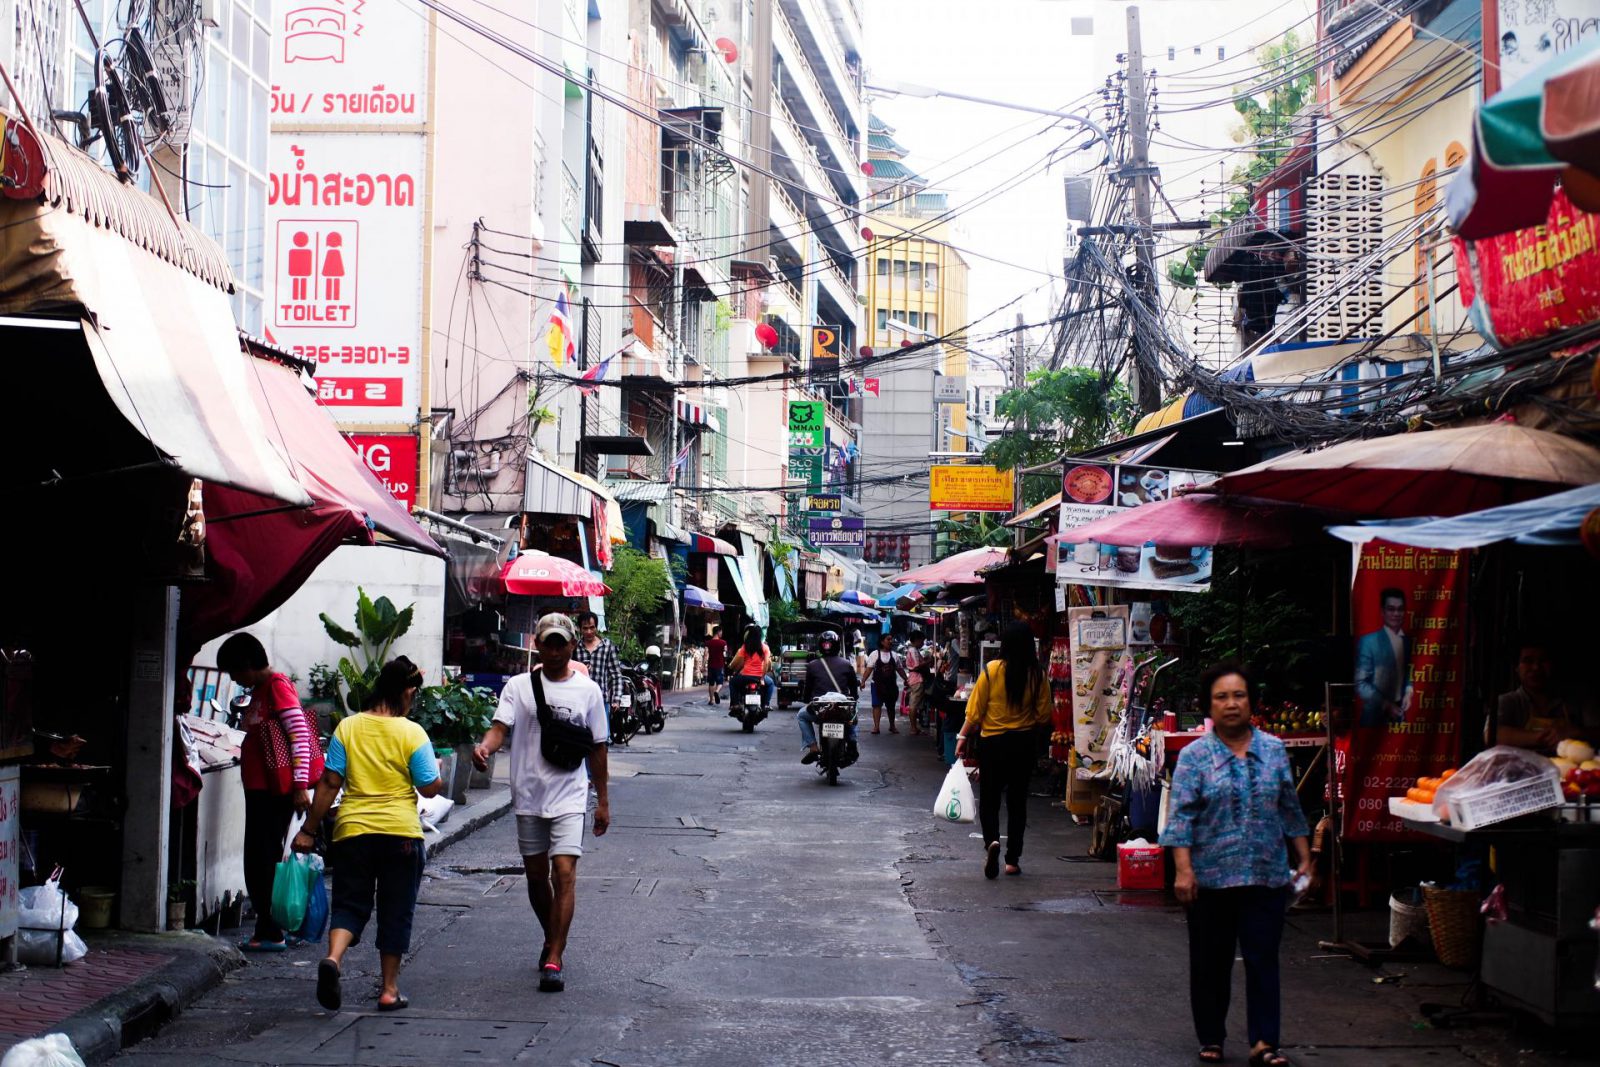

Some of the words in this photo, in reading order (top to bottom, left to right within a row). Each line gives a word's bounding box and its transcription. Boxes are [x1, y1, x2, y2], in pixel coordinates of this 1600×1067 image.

[323, 84, 415, 113] รายเดือน
[280, 305, 351, 321] TOILET
[318, 379, 354, 400] ชั้น
[365, 383, 387, 399] 2
[865, 381, 878, 389] KFC
[1065, 514, 1079, 522] Try
[518, 569, 550, 577] LEO
